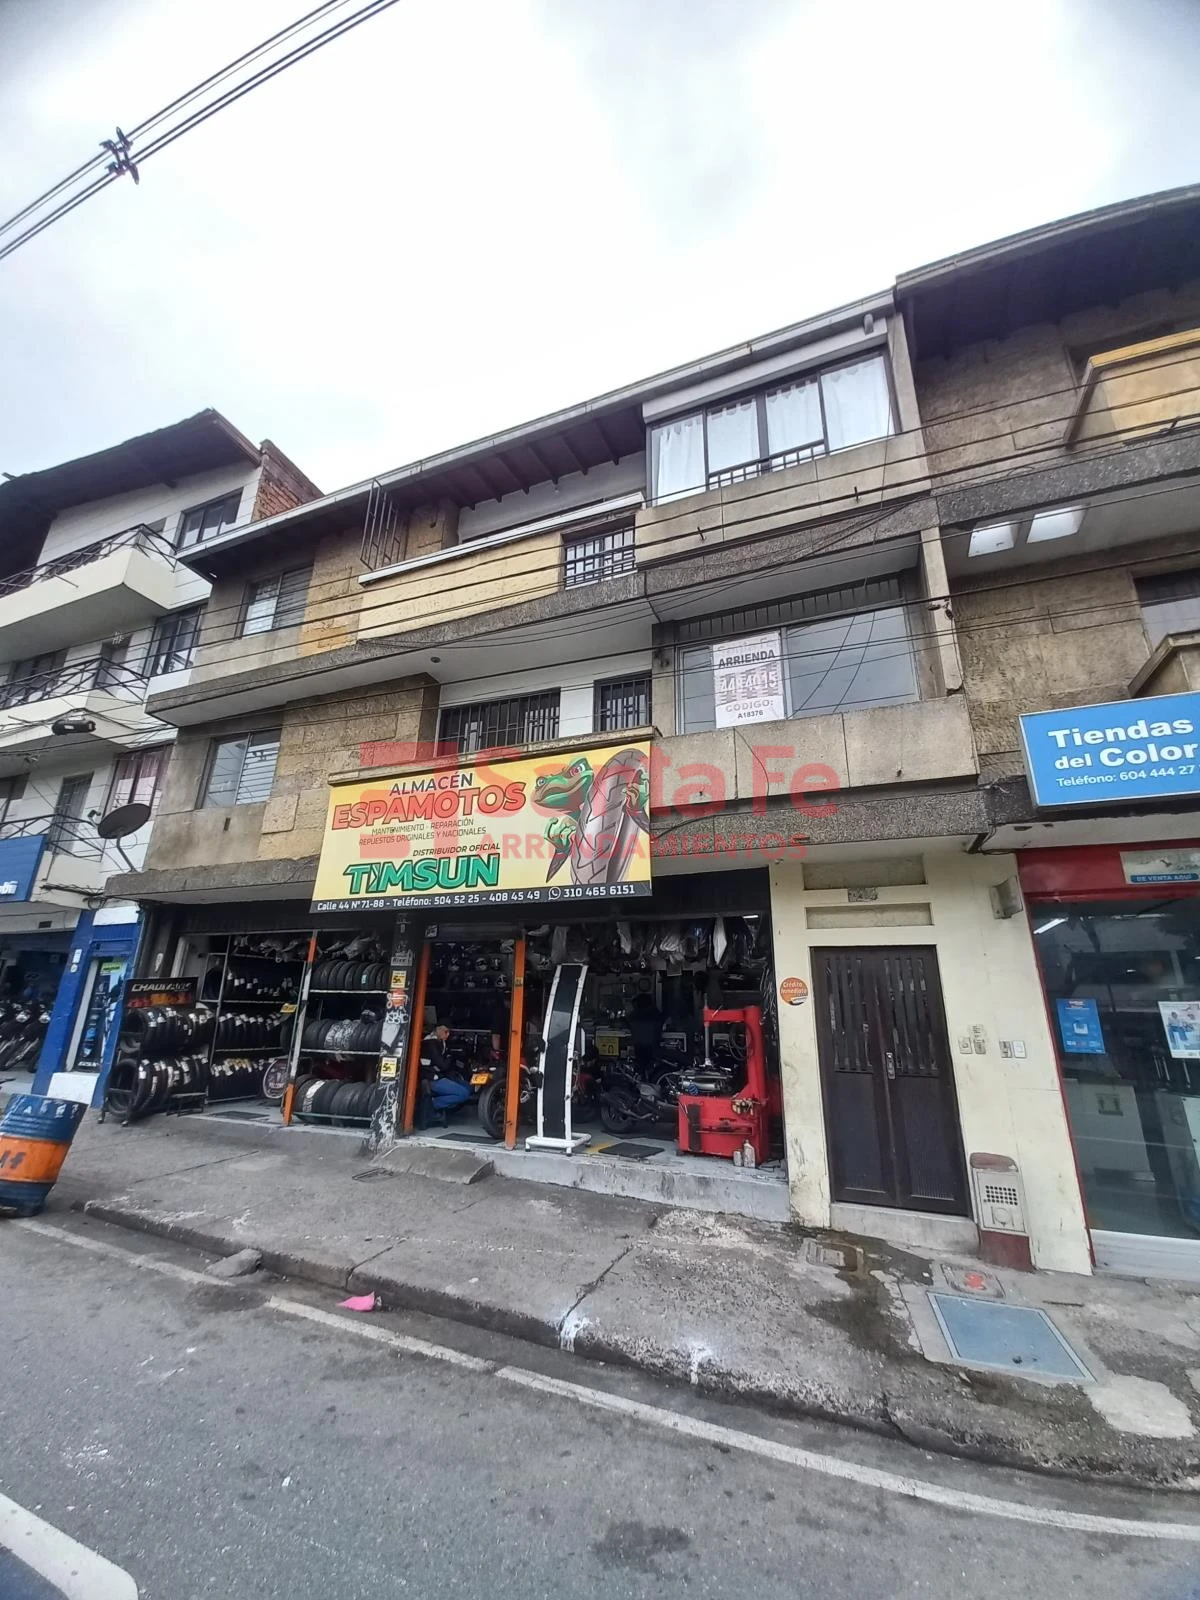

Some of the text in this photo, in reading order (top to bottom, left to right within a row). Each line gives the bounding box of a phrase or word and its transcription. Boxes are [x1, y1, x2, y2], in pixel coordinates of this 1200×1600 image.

[718, 649, 776, 668] ARRIENDA
[1048, 719, 1194, 748] Tiendas
[1054, 743, 1199, 770] del Color
[389, 772, 473, 796] ALMACÉN
[1056, 773, 1117, 787] Teléfono:
[1119, 770, 1147, 781] 604
[1150, 767, 1175, 778] 444
[1178, 765, 1195, 775] 27
[332, 781, 526, 830] ESPAMOTOS
[359, 835, 395, 846] REPUESTOS
[396, 832, 435, 843] ORIGINALES
[442, 827, 487, 838] NACIONALES
[371, 823, 425, 837] MANTENIMIENTO
[430, 818, 474, 830] REPARACIÓN
[412, 843, 501, 857] DISTRIBUIDOR OFICIAL
[343, 853, 500, 895] TIMSUN
[317, 902, 337, 911] Calle
[338, 901, 350, 910] 44
[392, 896, 432, 907] Teléfono:
[433, 895, 451, 905] 504
[453, 895, 465, 904] 52
[467, 894, 480, 903] 25
[489, 892, 508, 902] 408
[511, 891, 524, 901] 45
[527, 890, 540, 900] 49
[563, 888, 582, 898] 310
[585, 886, 606, 896] 465
[609, 884, 635, 895] 6151
